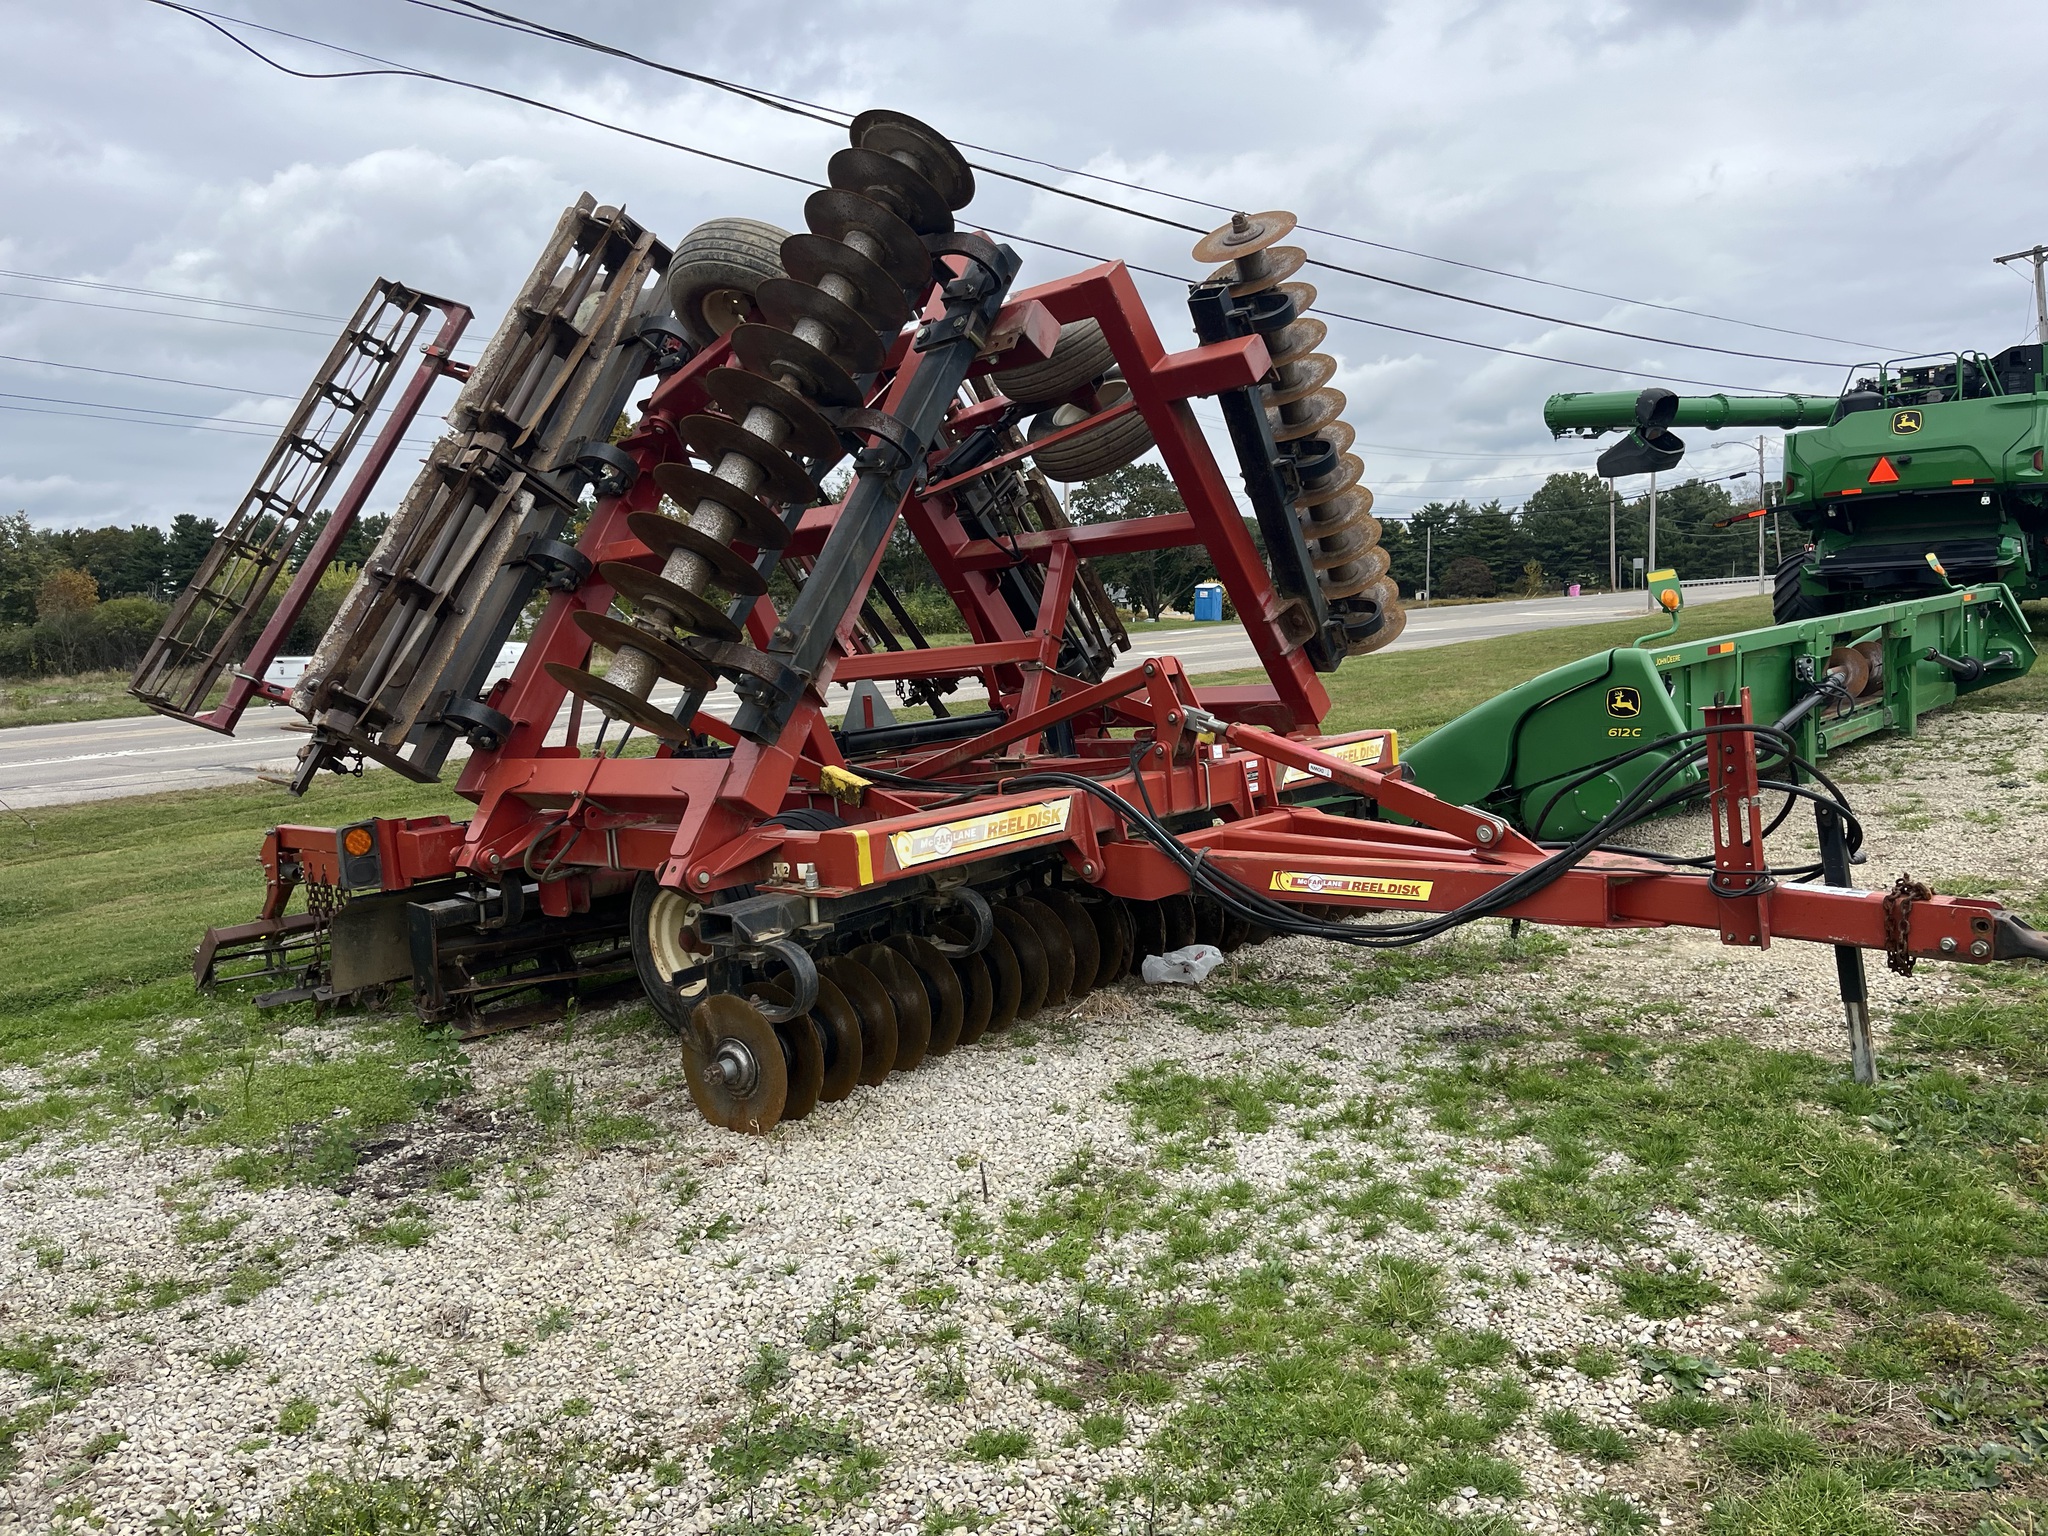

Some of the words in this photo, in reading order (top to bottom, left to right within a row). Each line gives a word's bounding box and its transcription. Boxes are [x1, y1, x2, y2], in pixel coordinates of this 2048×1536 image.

[1360, 744, 1381, 758] DISK
[987, 816, 1025, 838] REEL
[1027, 807, 1061, 828] DISK
[1351, 881, 1386, 893] REEL
[1387, 884, 1421, 895] DISK
